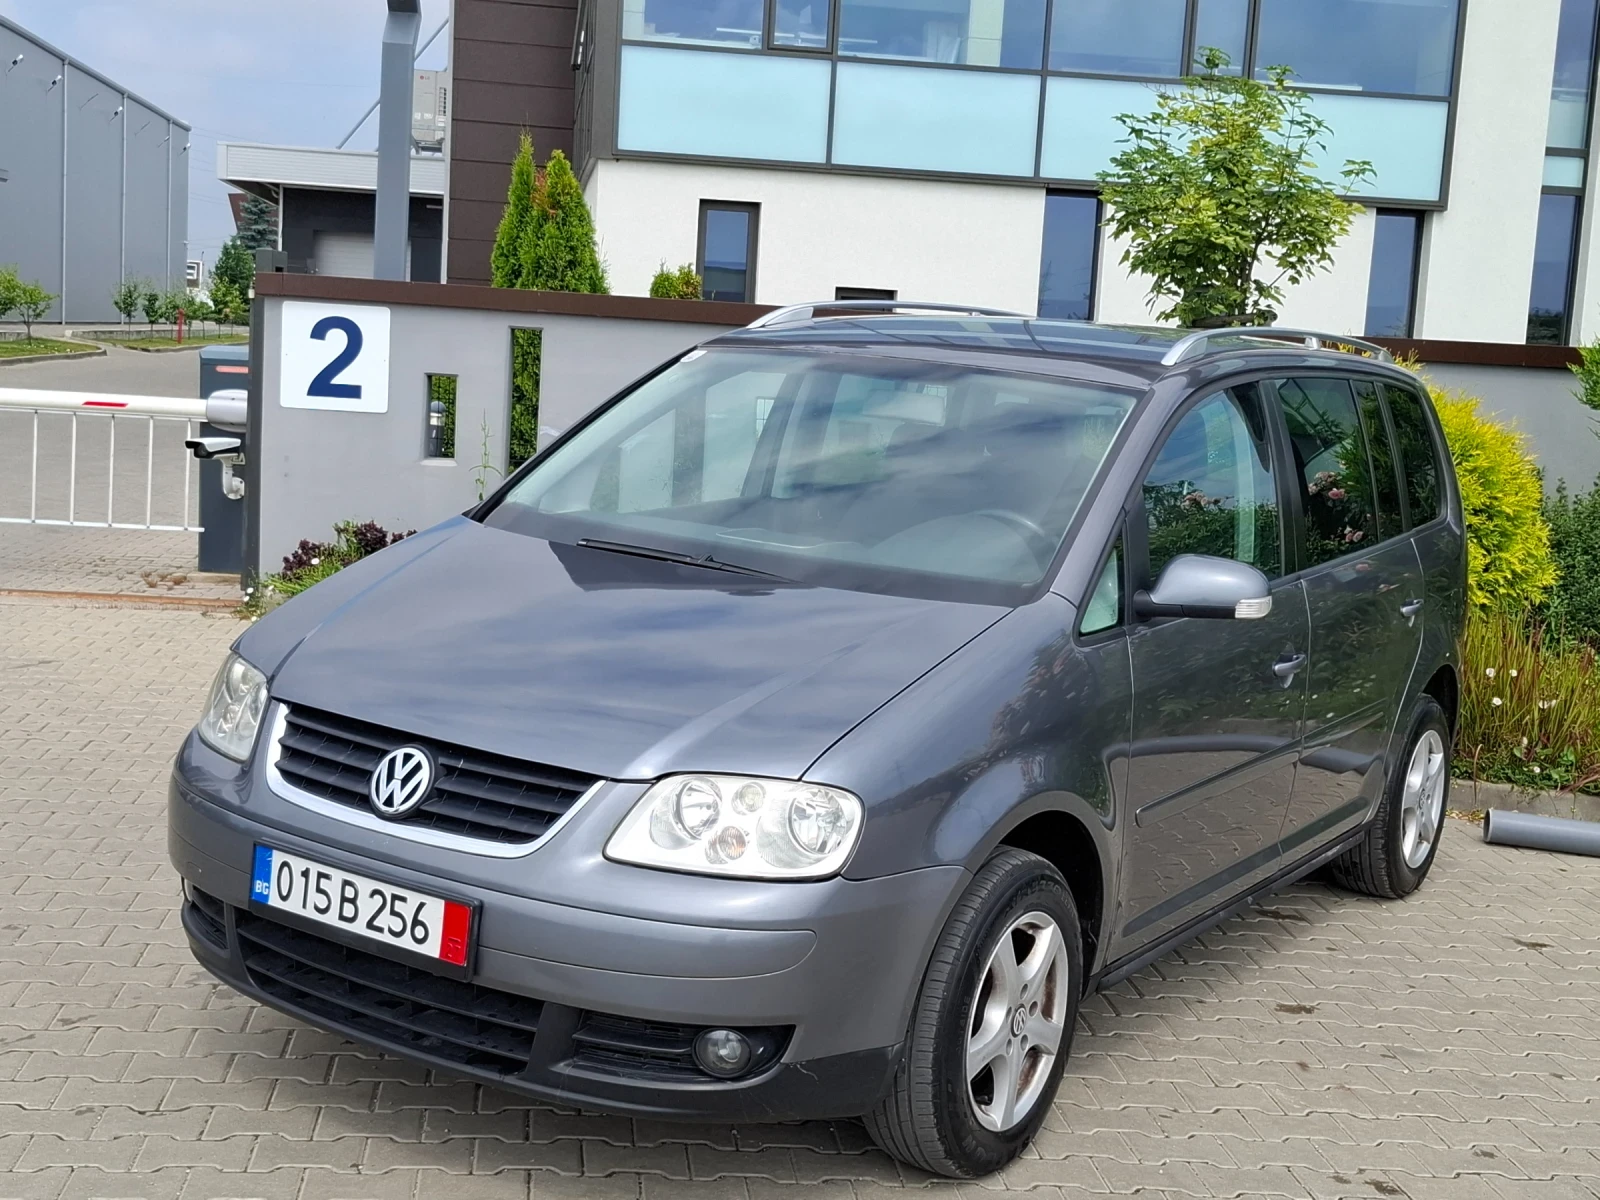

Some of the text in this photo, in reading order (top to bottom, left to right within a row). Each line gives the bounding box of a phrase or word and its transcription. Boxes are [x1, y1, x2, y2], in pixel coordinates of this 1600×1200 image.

[306, 316, 363, 399] 2
[255, 860, 429, 945] BG 015B256
